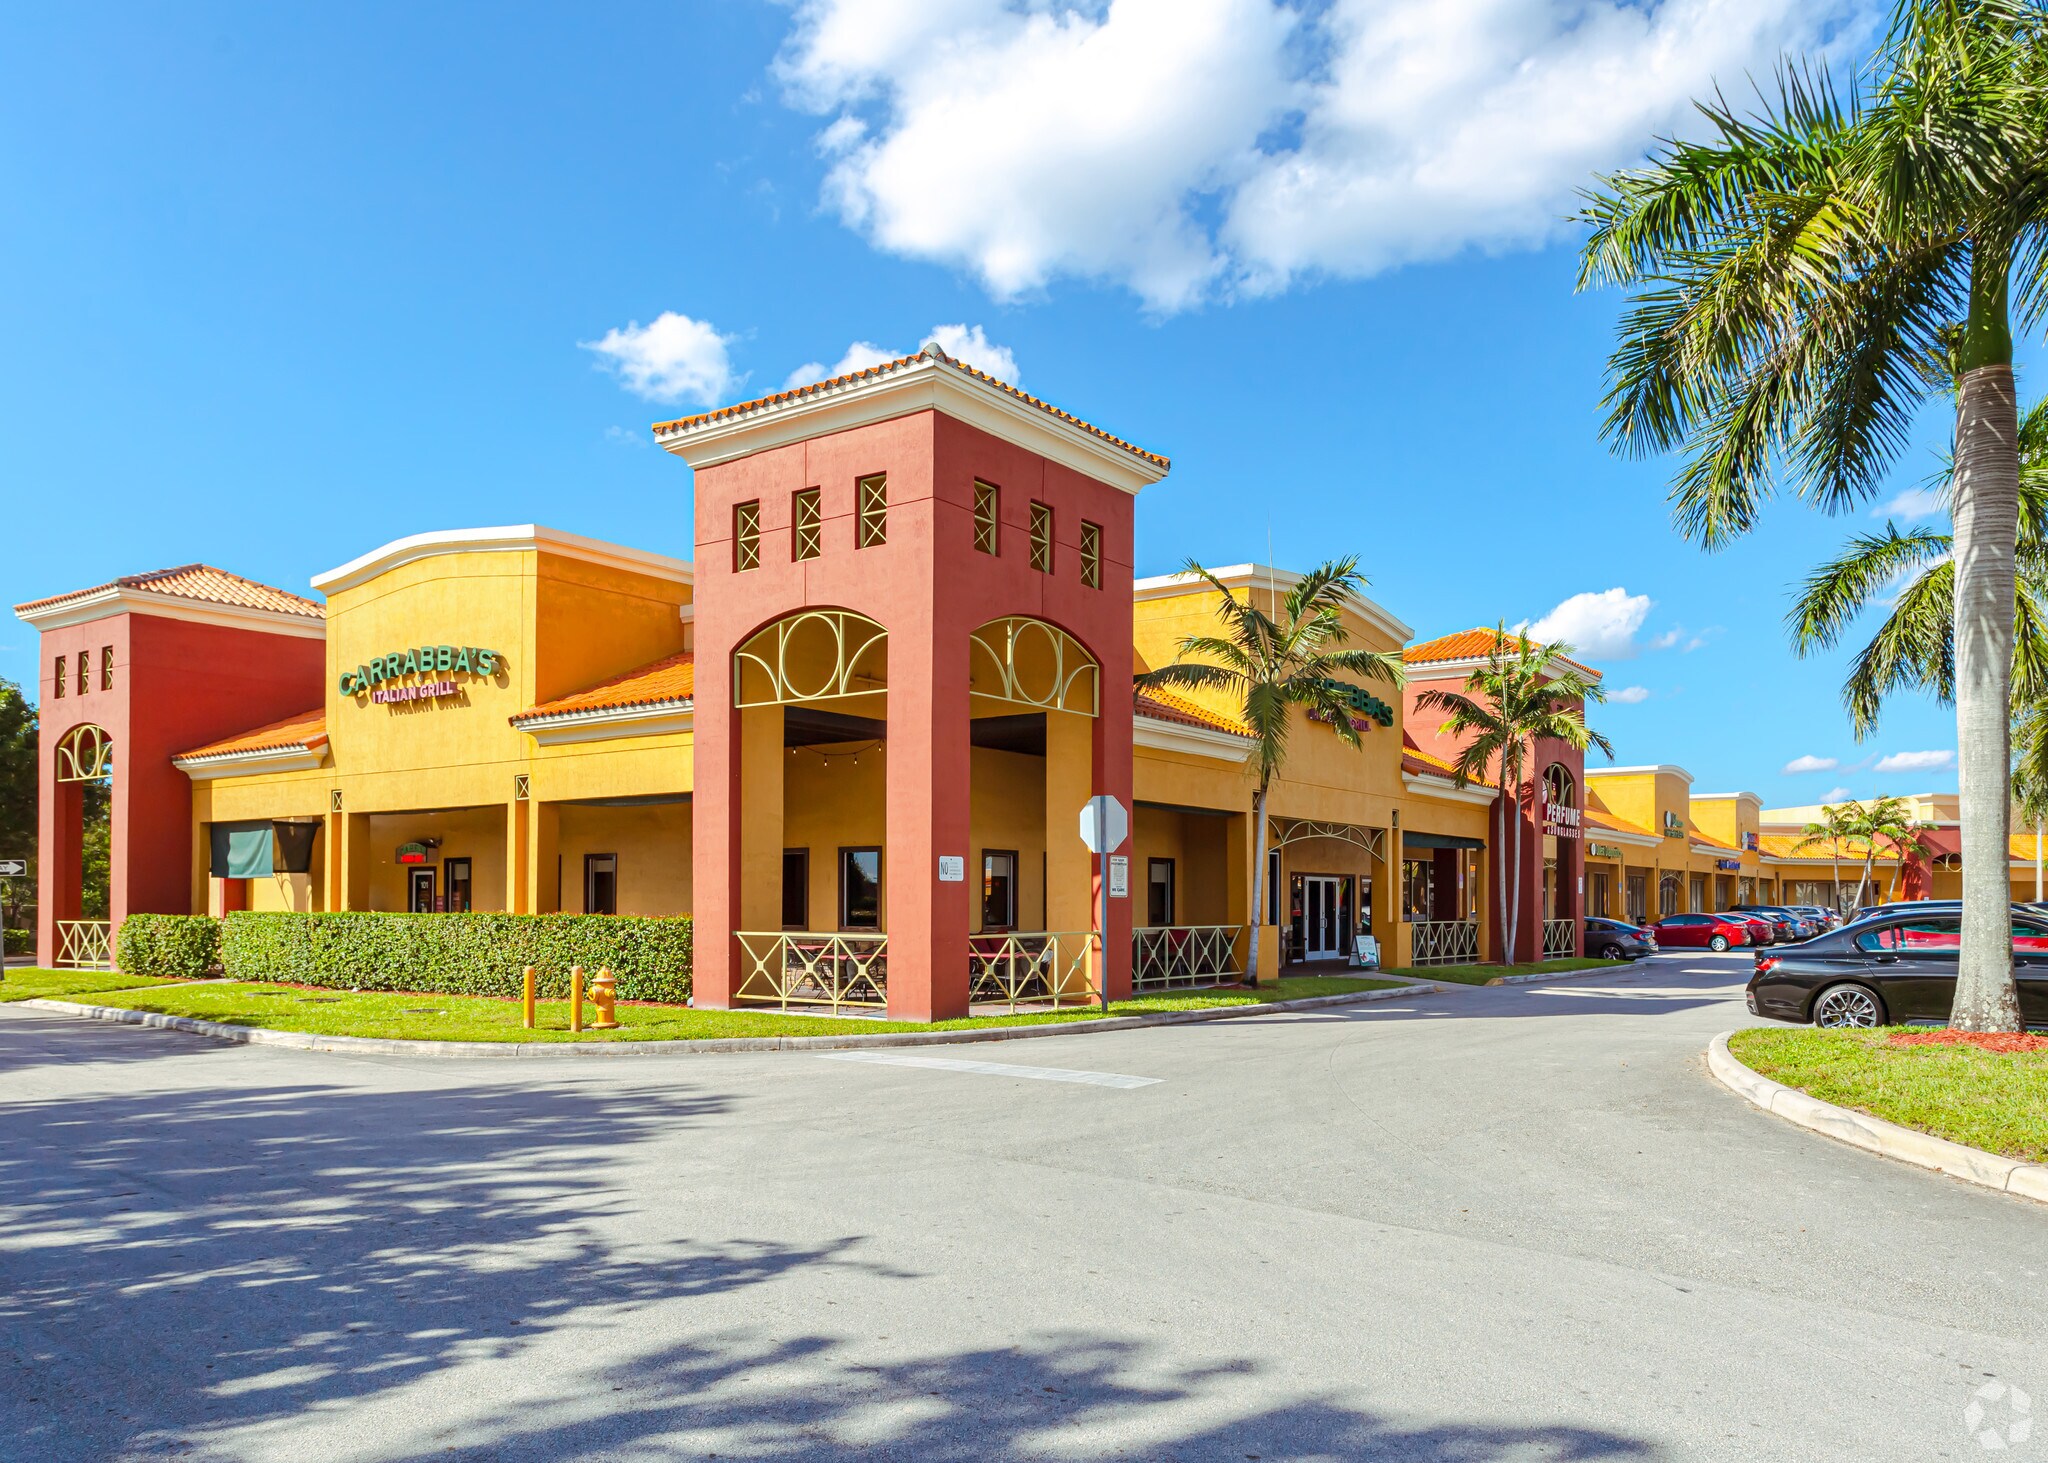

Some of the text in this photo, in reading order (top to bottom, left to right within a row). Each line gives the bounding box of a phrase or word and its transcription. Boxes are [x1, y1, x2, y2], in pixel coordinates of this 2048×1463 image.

[338, 645, 493, 696] CARRABBA'S
[372, 681, 454, 704] ITALIAN GRILL
[1547, 803, 1580, 826] PERFUME
[940, 861, 949, 875] NO
